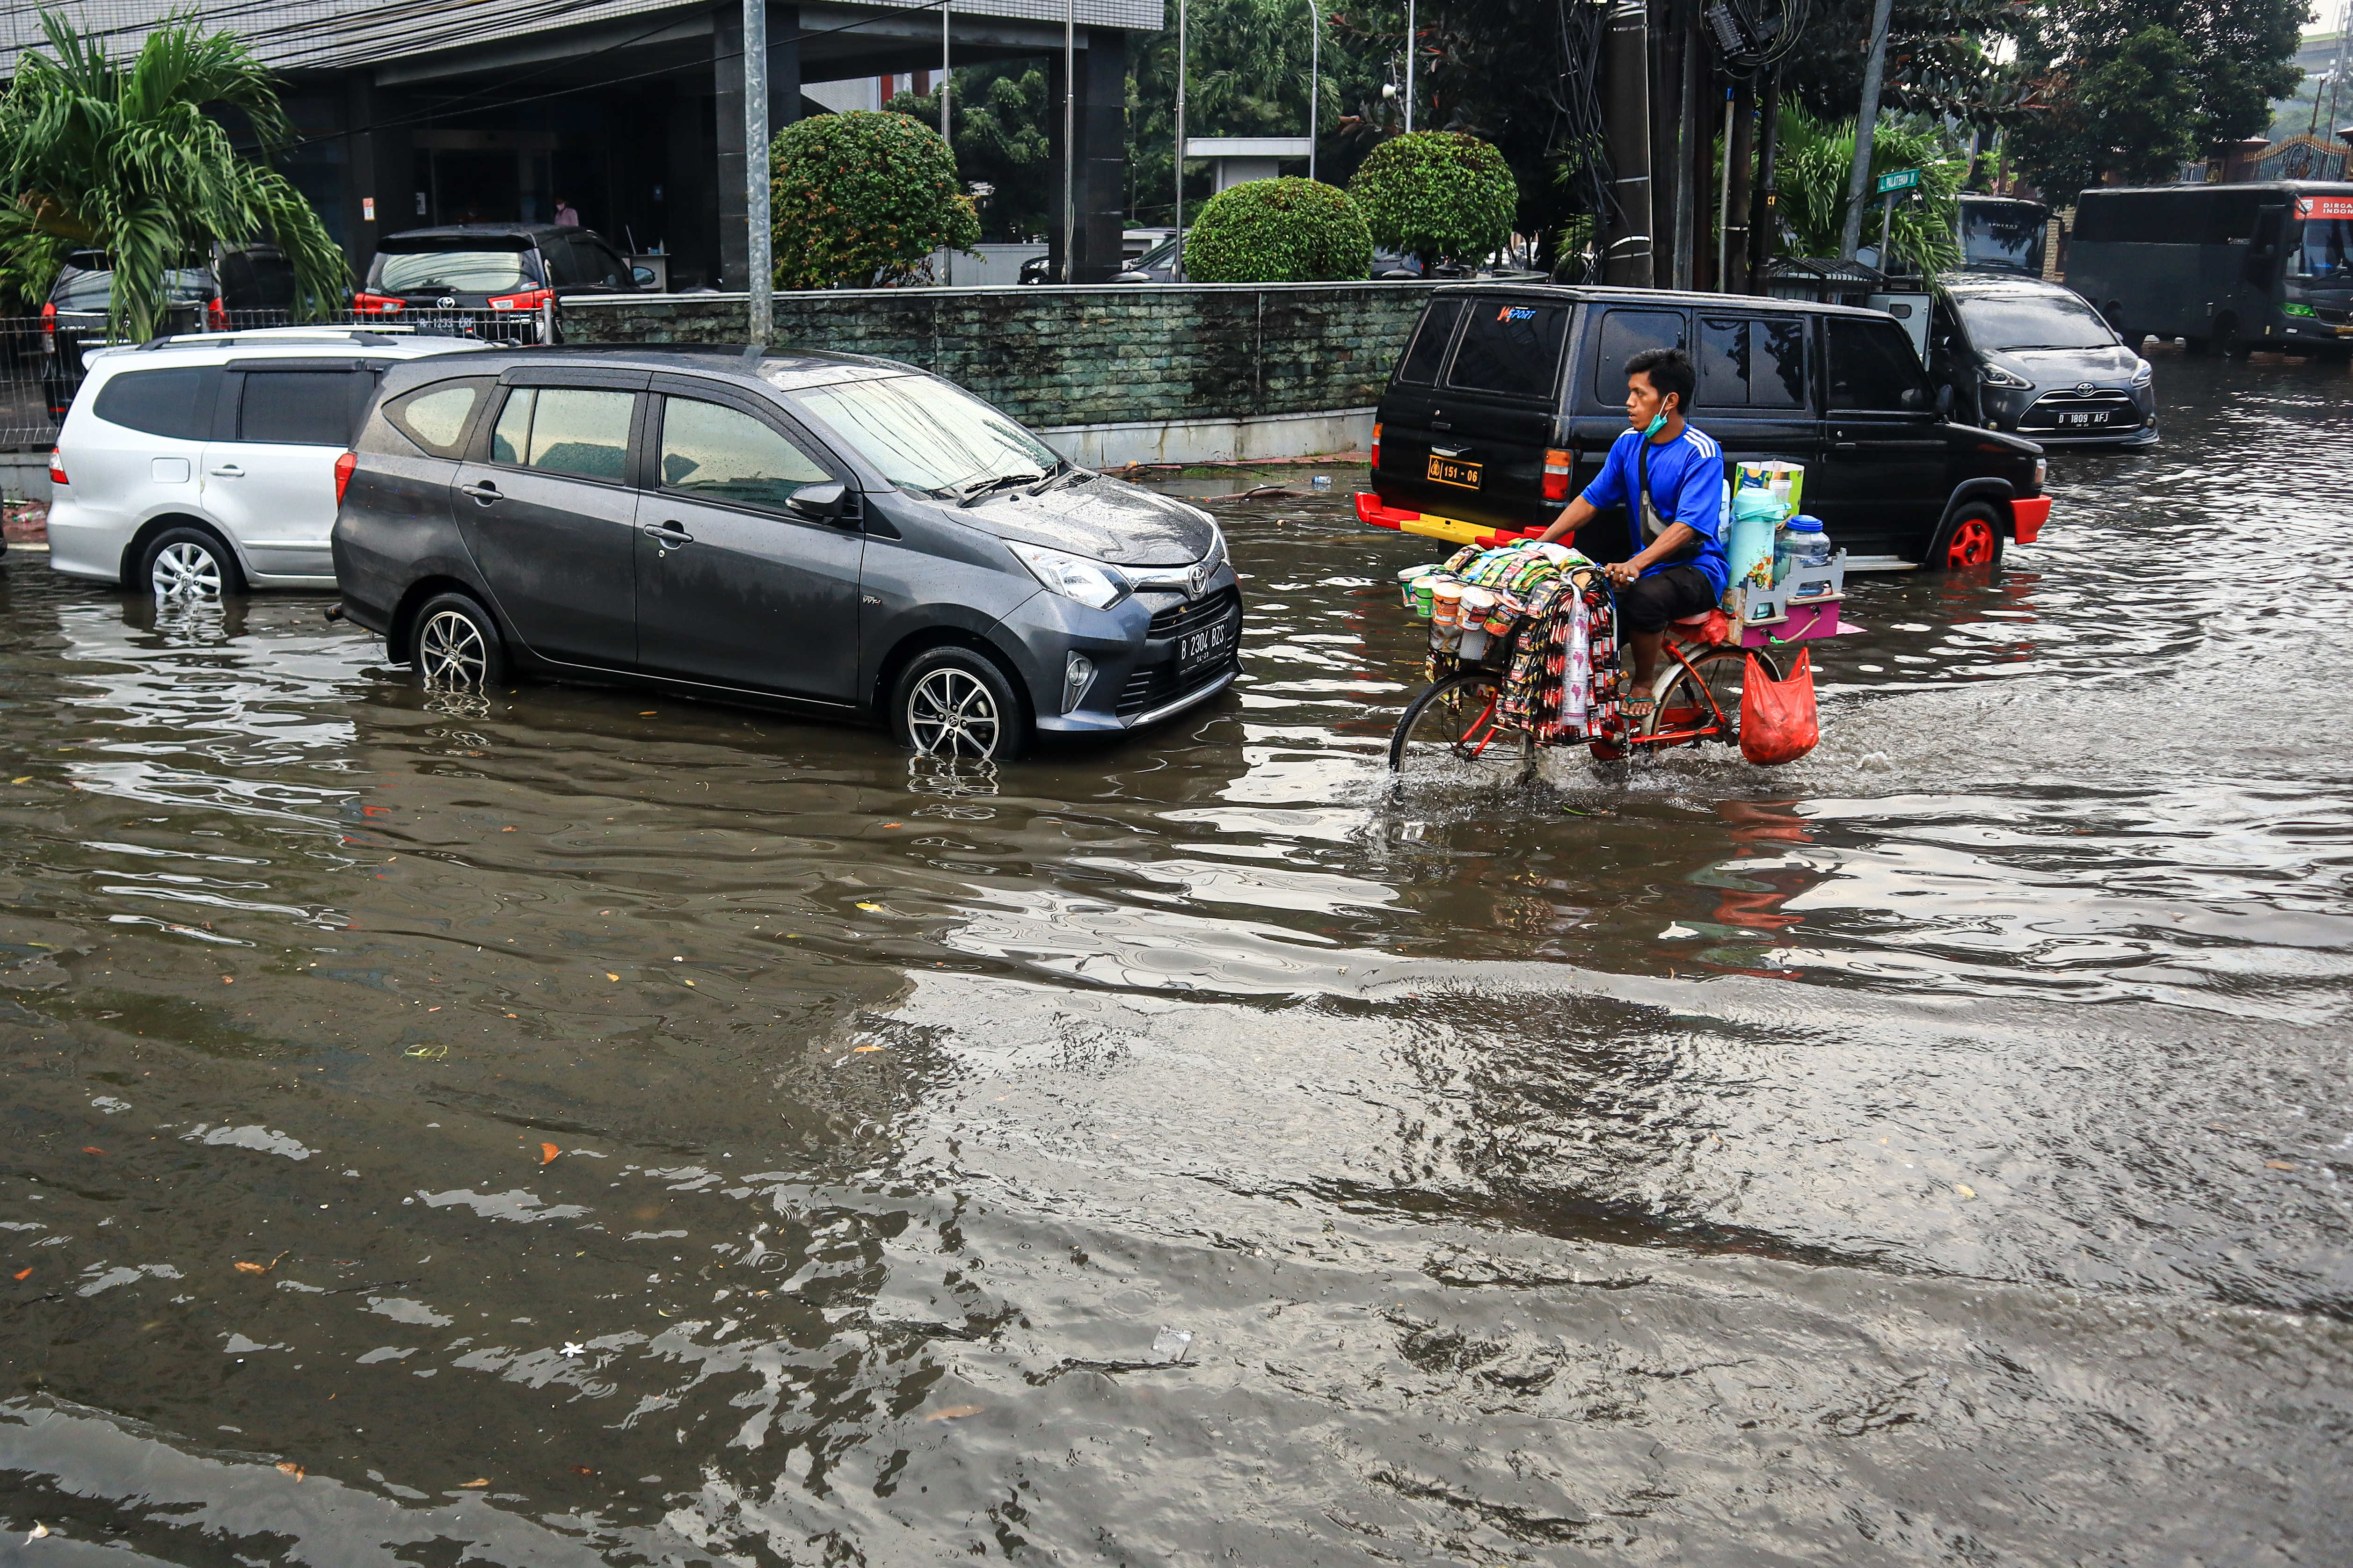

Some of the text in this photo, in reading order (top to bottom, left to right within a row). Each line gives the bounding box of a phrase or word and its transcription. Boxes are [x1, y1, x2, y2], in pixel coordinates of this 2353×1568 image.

[2059, 413, 2109, 423] D 1809 AFJ
[1444, 466, 1457, 479] 151
[1467, 470, 1478, 482] 06
[1181, 624, 1224, 660] B 2304 BZS
